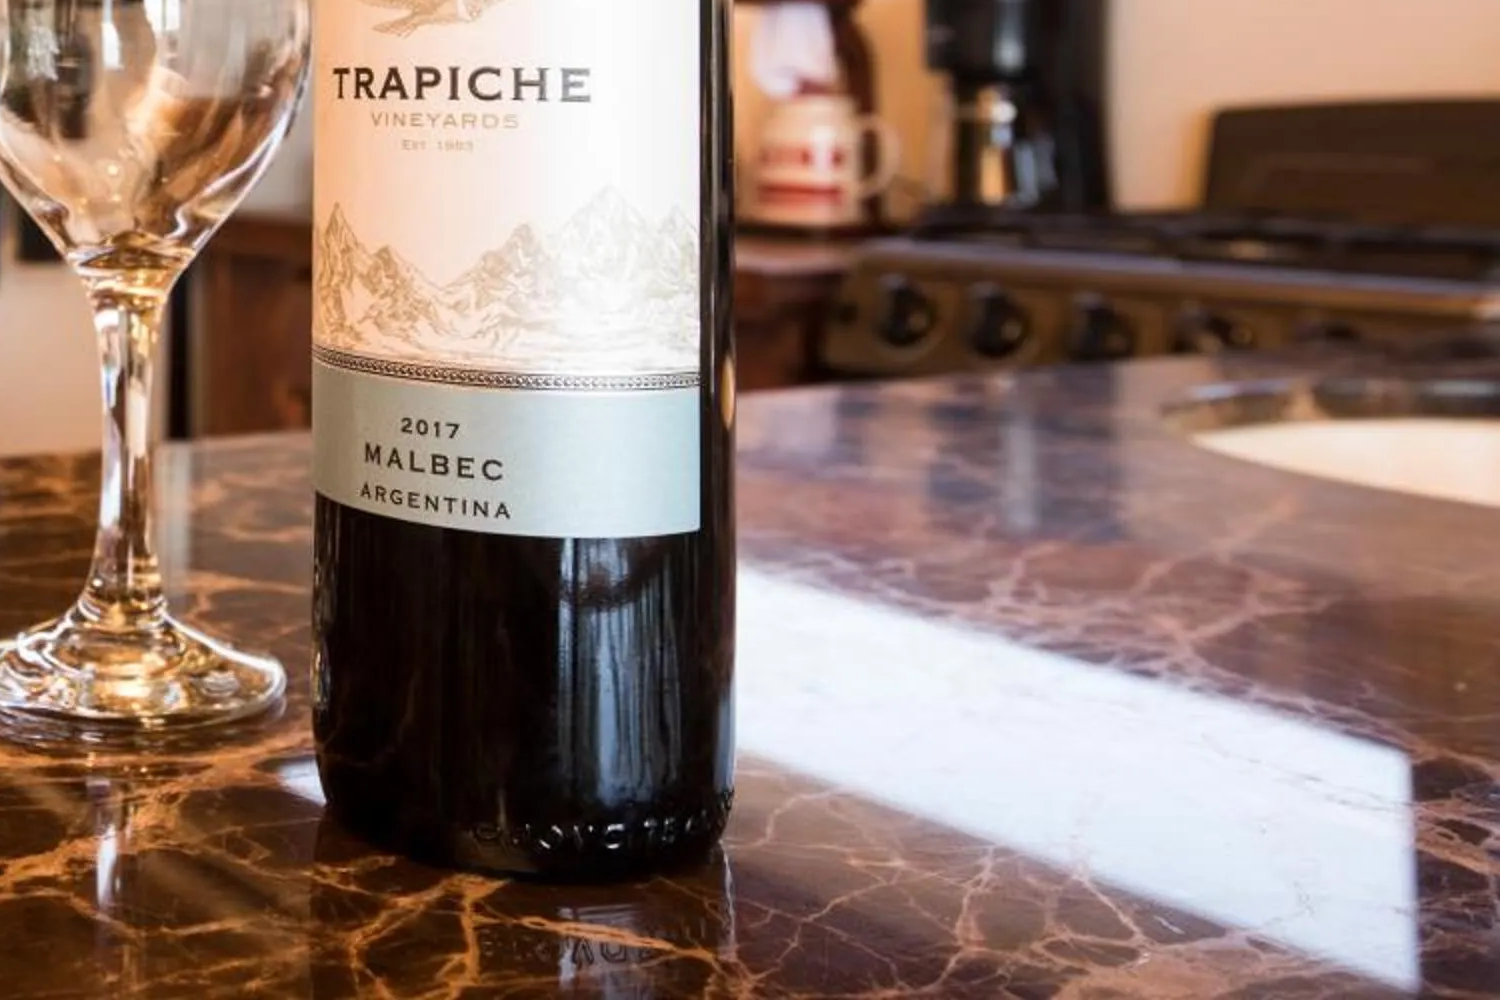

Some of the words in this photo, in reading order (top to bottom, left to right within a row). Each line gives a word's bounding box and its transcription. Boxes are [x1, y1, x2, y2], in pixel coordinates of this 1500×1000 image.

[332, 66, 592, 103] TRAPICHE
[371, 112, 520, 130] VINEYARDS
[400, 416, 461, 440] 2017
[364, 442, 505, 482] MALBEC
[359, 482, 512, 520] ARGENTINA
